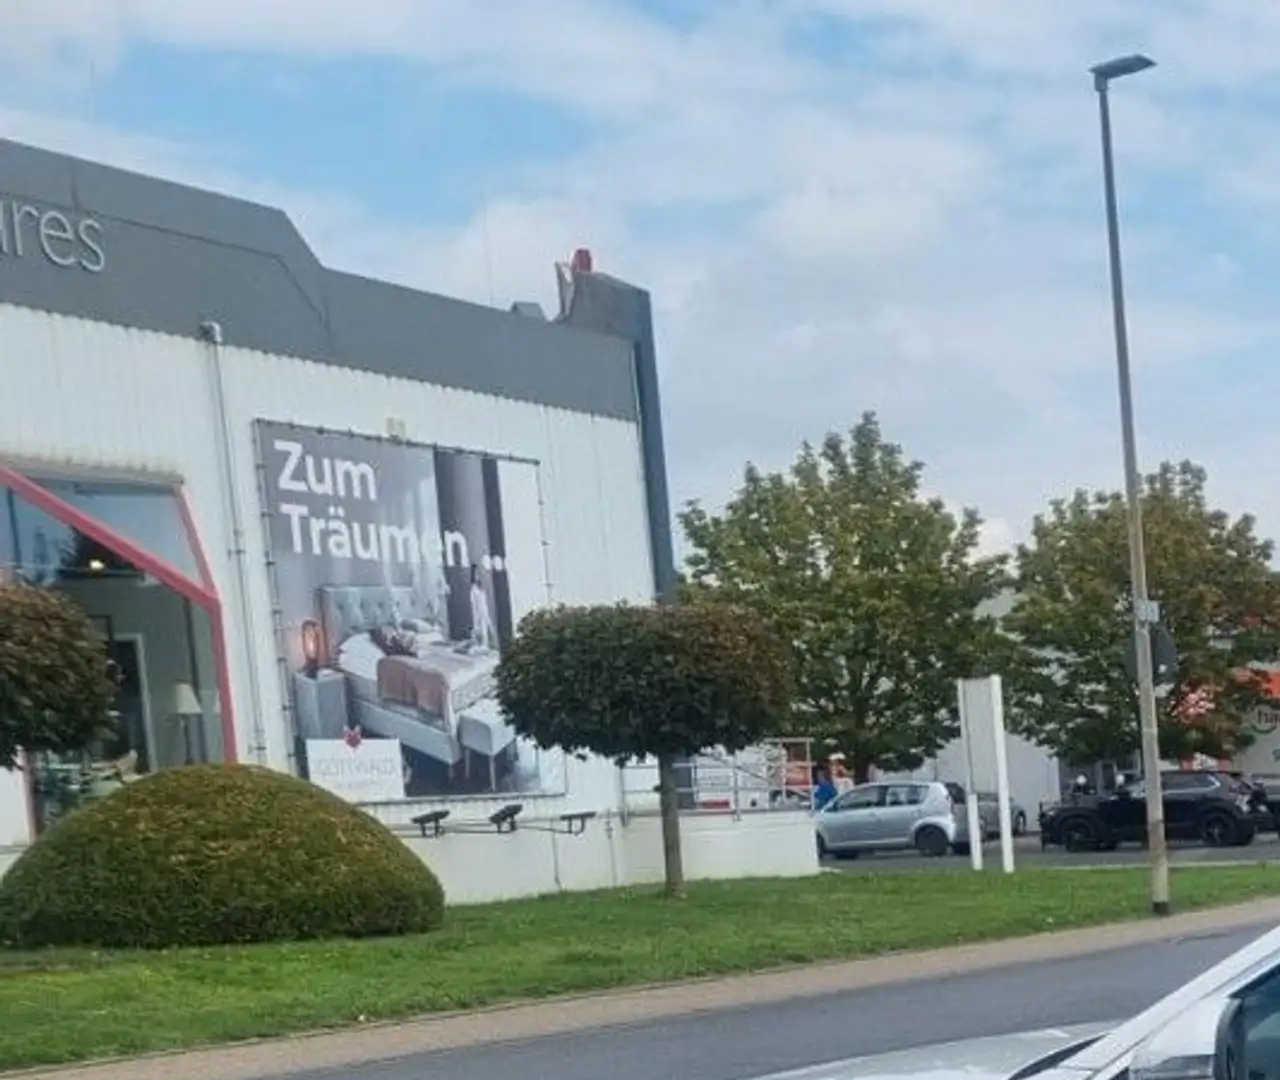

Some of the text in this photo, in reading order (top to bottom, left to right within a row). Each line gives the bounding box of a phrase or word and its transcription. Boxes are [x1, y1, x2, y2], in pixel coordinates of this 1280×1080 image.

[0, 200, 105, 271] res
[274, 440, 377, 501] Zum
[280, 504, 471, 568] Träumen
